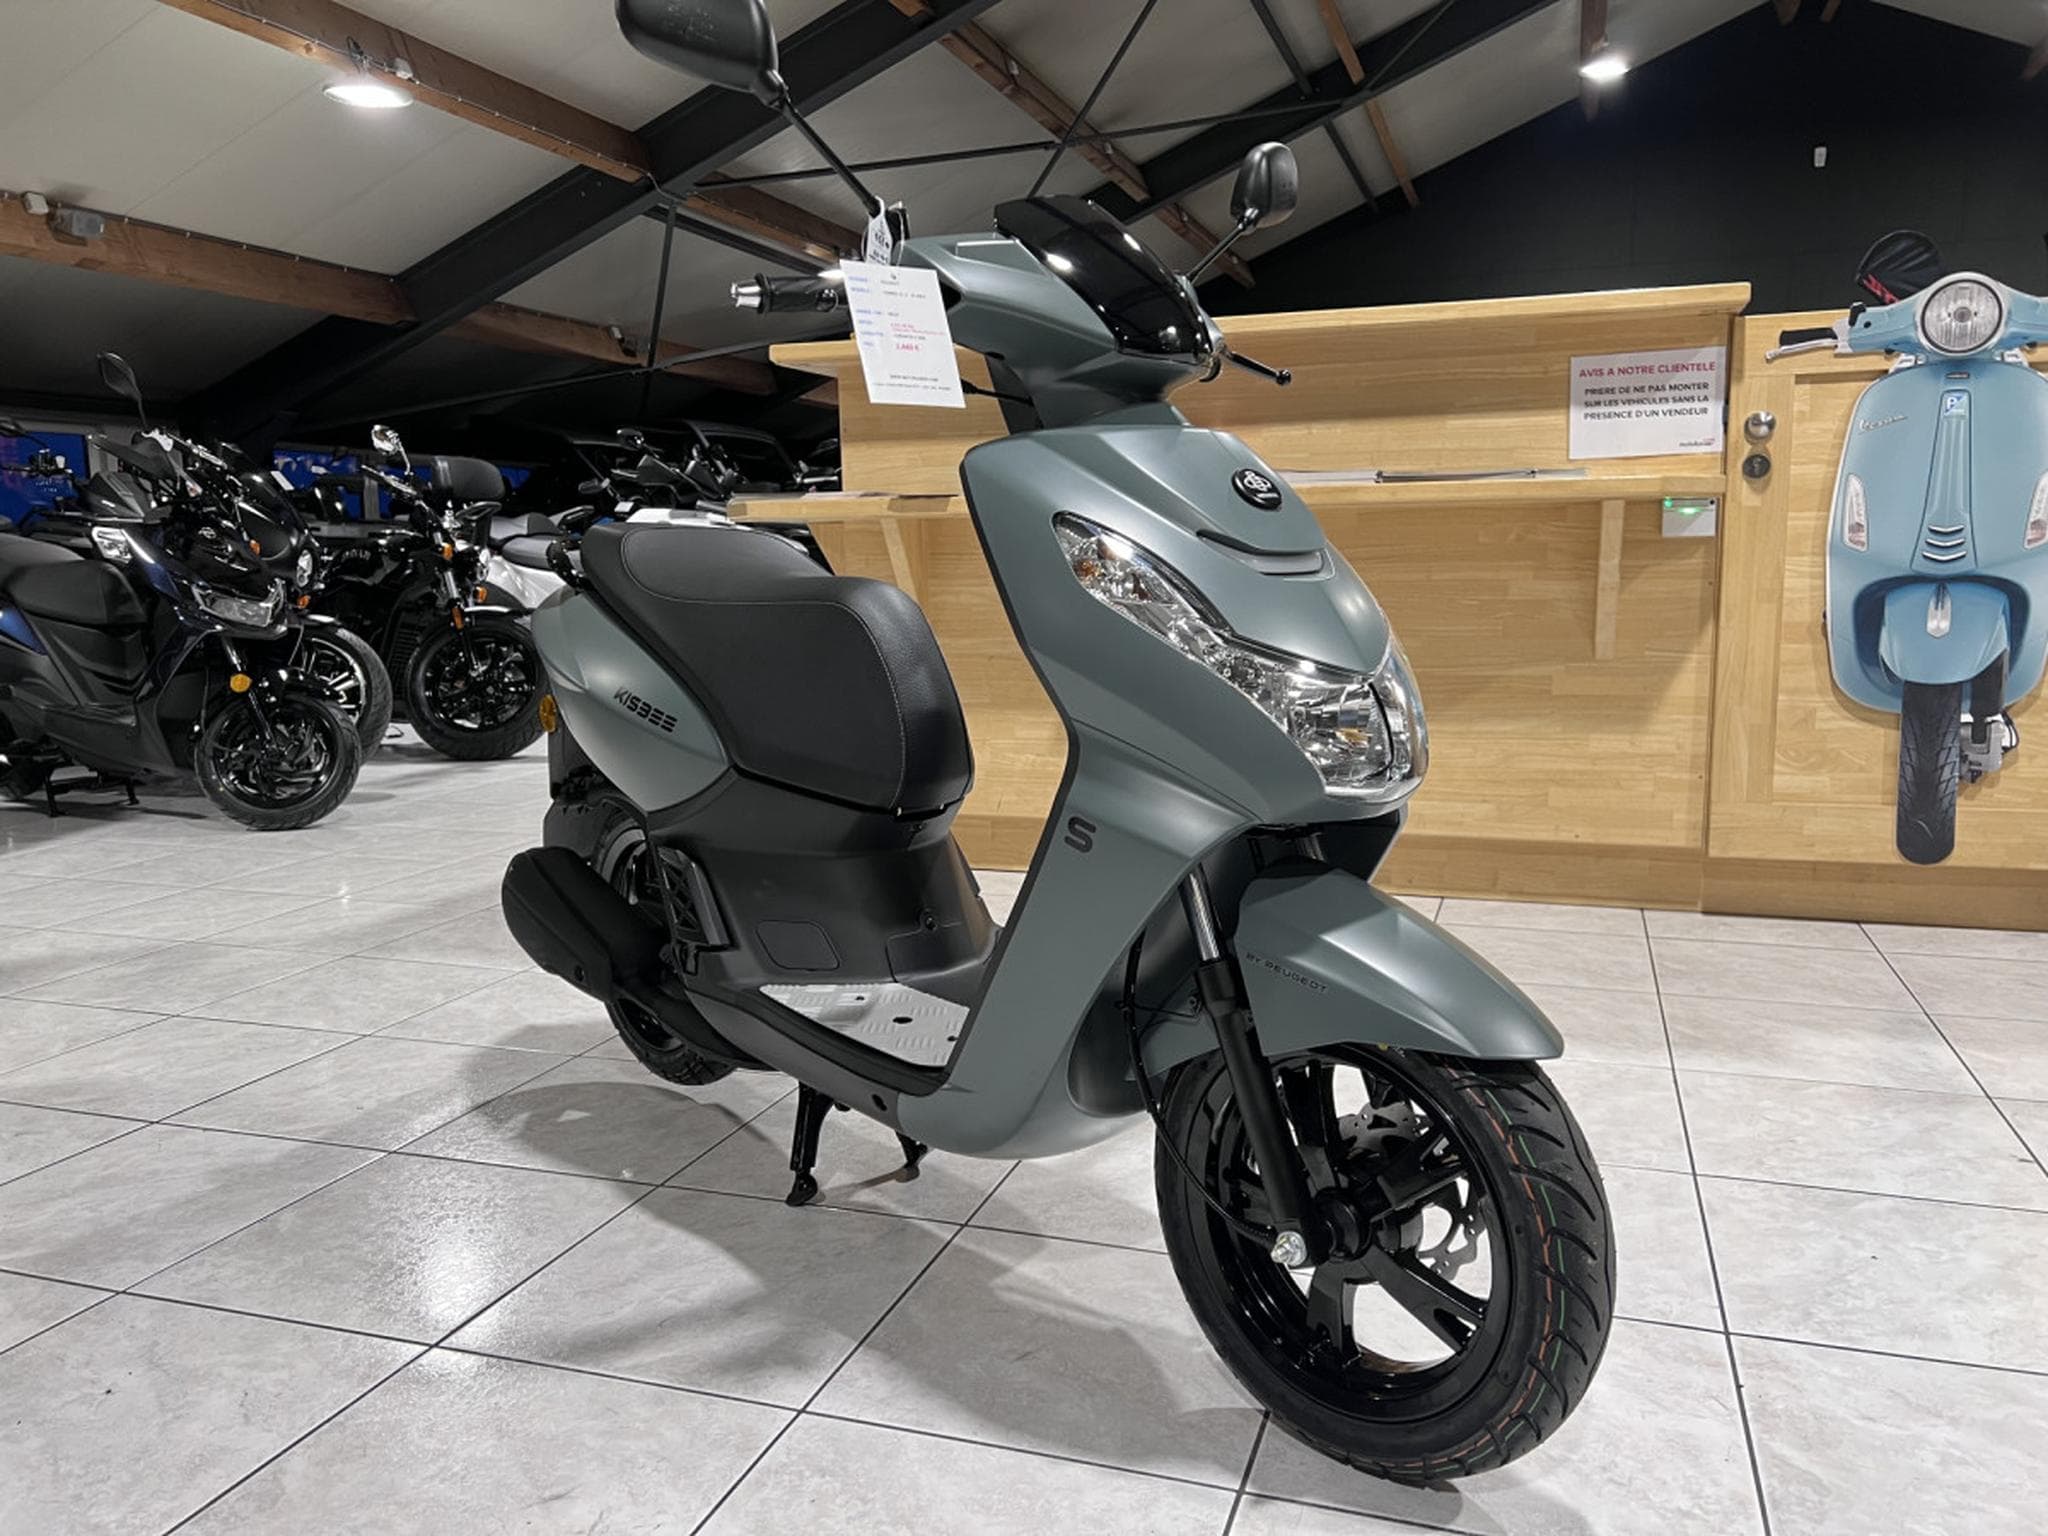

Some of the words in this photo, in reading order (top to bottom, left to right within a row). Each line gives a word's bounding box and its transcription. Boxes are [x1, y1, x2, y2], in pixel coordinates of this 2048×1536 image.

[1579, 369, 1604, 378] AVIS
[1617, 364, 1654, 375] NOTRE
[1657, 362, 1716, 373] CLIENTELE
[1585, 387, 1616, 395] PRIERE
[1619, 386, 1630, 394] DE
[1633, 385, 1645, 393] NE
[1648, 384, 1666, 392] PAS
[1669, 382, 1709, 391] MONTER
[1584, 400, 1602, 408] SUR
[1604, 399, 1619, 407] LES
[1621, 397, 1670, 406] VEHICULES
[1672, 396, 1695, 404] SANS
[1584, 411, 1632, 420] PRESENCE
[1635, 409, 1660, 417] D'UN
[1662, 407, 1708, 416] VENDEUR
[614, 686, 678, 733] KISBEE
[1064, 816, 1097, 854] S
[1265, 959, 1327, 992] PEUGEOT
